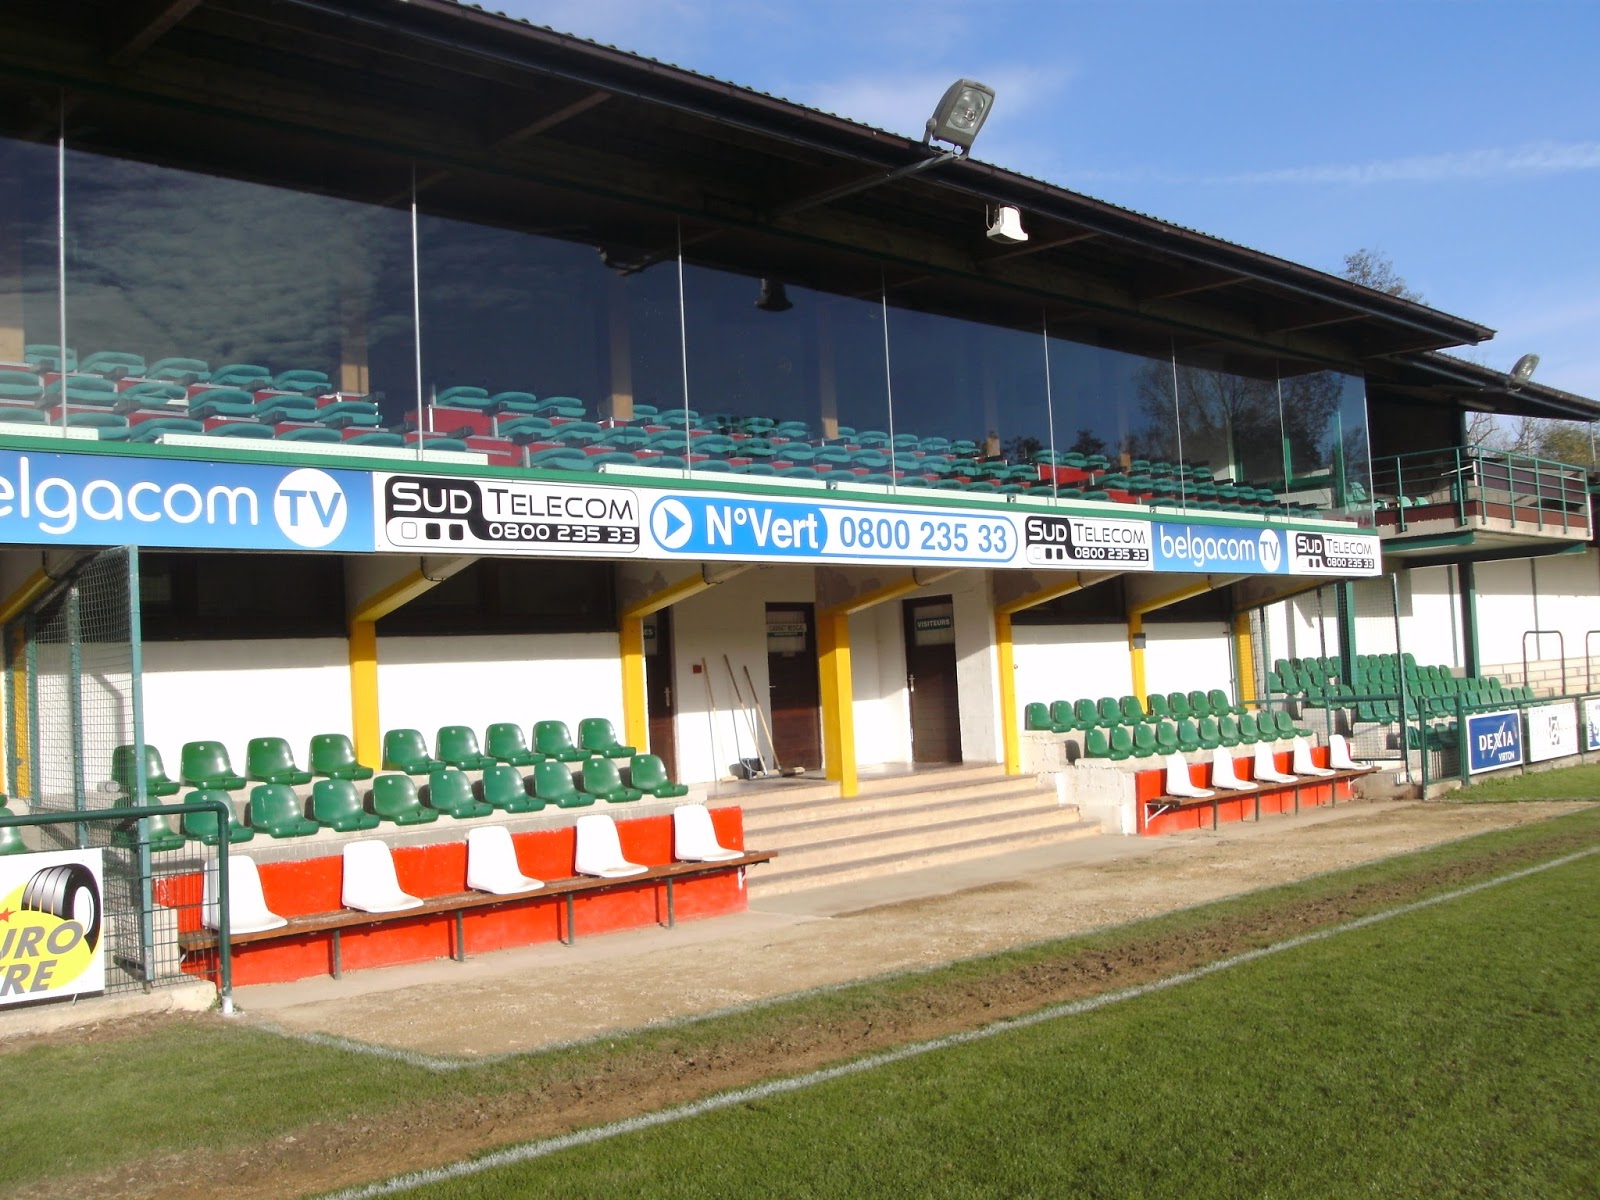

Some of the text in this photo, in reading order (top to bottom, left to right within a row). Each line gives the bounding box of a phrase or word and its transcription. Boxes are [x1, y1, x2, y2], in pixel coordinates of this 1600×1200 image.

[280, 489, 342, 528] TV
[391, 482, 634, 521] SUD TELECOM
[488, 522, 636, 543] 0800 235 33
[839, 516, 1007, 553] 0800 235 33
[1028, 519, 1145, 544] SUD TELECOM
[1074, 547, 1147, 560] 0800 235 33
[1160, 525, 1280, 567] belgacom TV
[1297, 536, 1372, 555] SUD TELECOM
[1327, 557, 1373, 568] 0800 235 33
[917, 618, 950, 628] VISITEURS
[1479, 730, 1514, 751] DEXIA
[1498, 751, 1515, 762] VIRTON
[0, 960, 58, 997] RE
